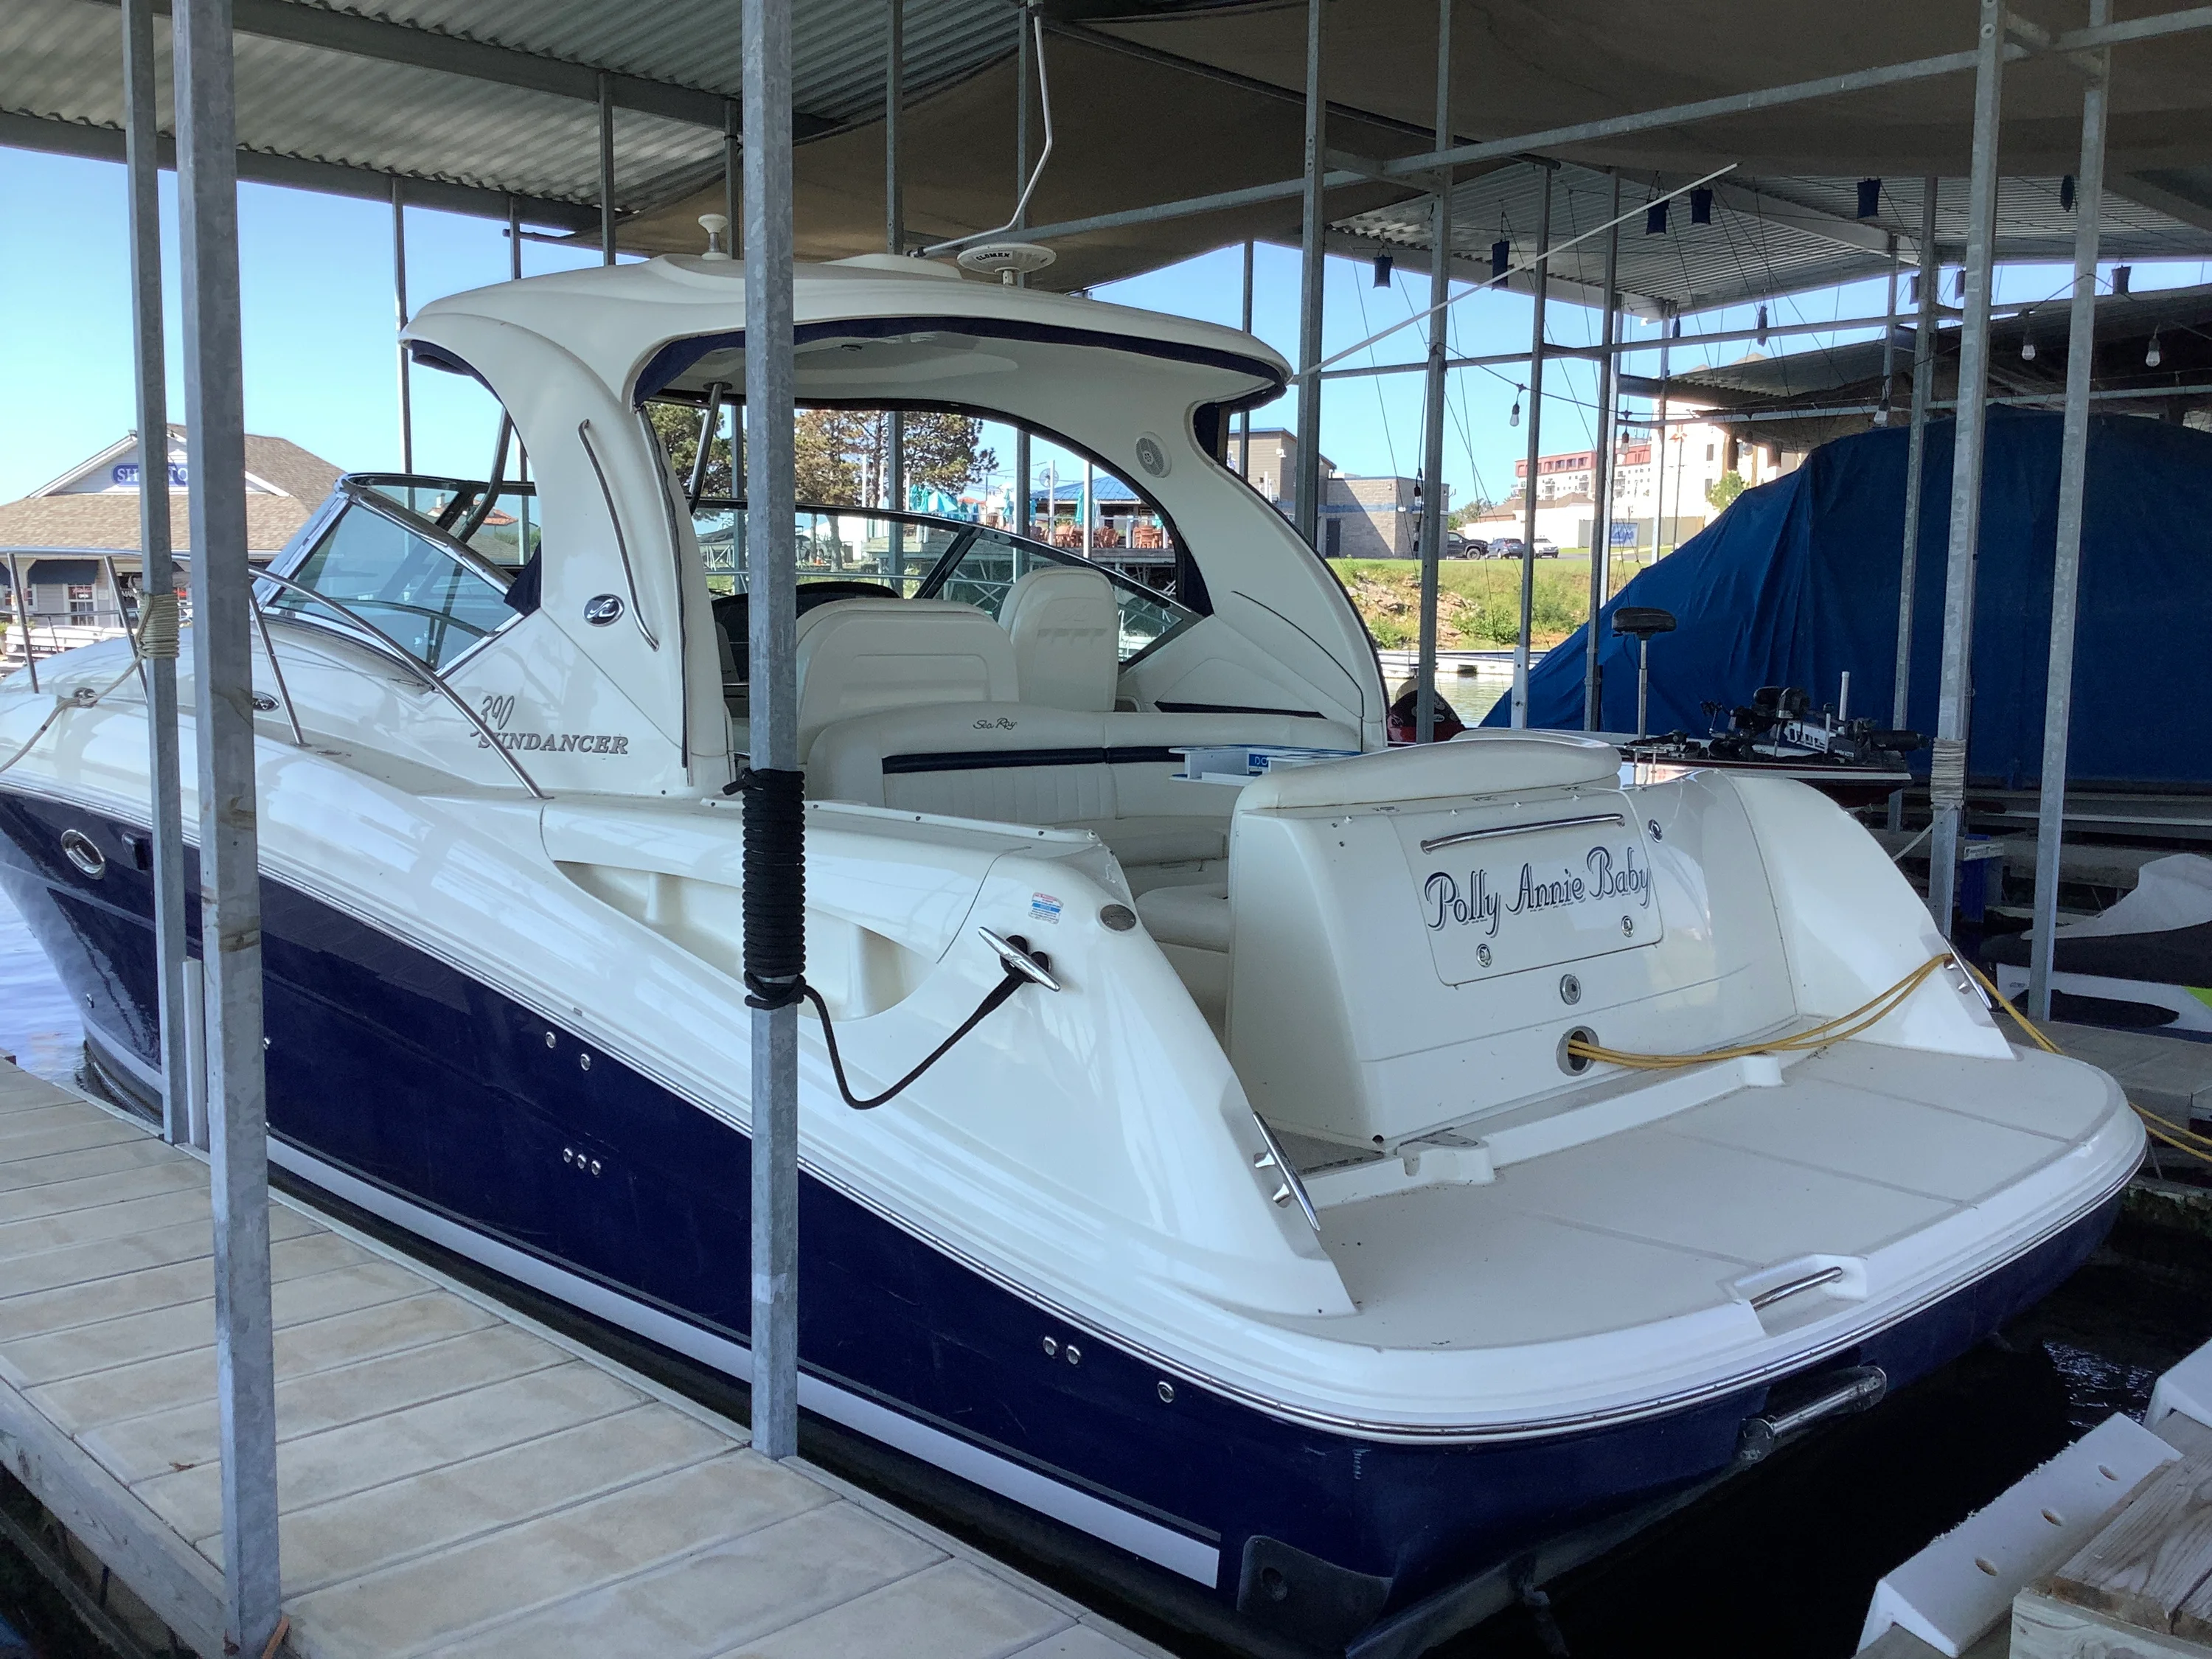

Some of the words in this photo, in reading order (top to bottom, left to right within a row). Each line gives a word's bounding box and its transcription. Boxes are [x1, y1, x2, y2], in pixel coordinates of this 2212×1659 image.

[975, 252, 1010, 261] GLOMEX
[973, 720, 995, 729] Sea
[995, 717, 1018, 730] Ray
[1424, 869, 1500, 938] Polly
[1505, 863, 1586, 915] Annie
[1587, 846, 1650, 908] Baby
